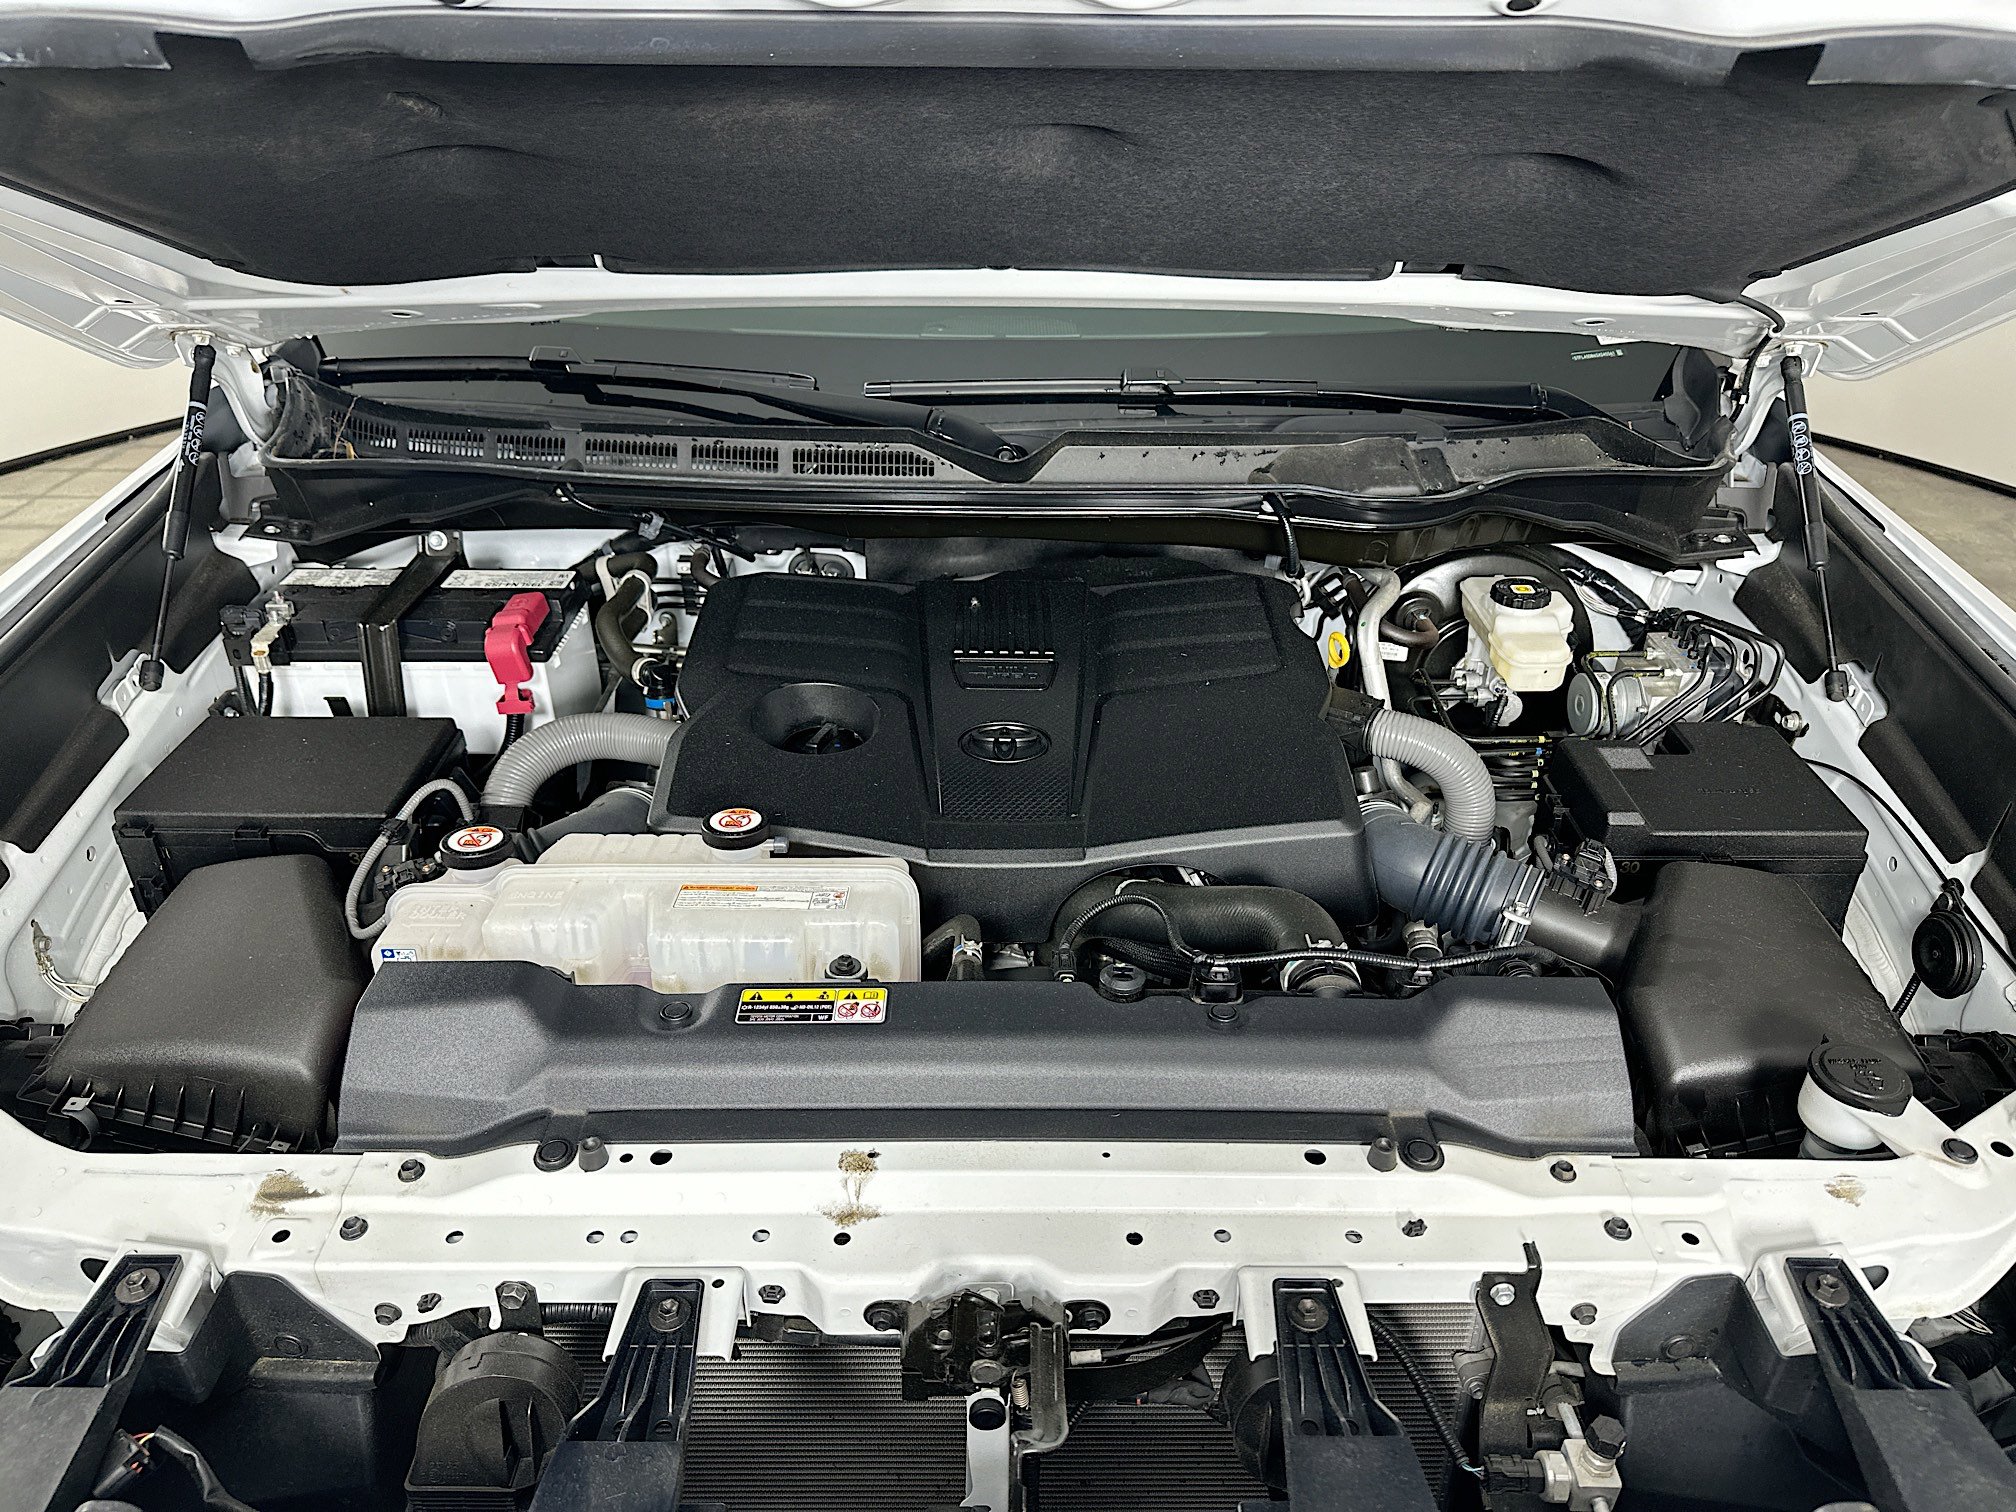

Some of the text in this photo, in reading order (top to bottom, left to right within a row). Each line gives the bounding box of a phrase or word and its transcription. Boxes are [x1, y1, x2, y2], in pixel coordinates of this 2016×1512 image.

[348, 852, 365, 865] 3
[1619, 861, 1641, 874] 30
[509, 890, 565, 899] ENGINE
